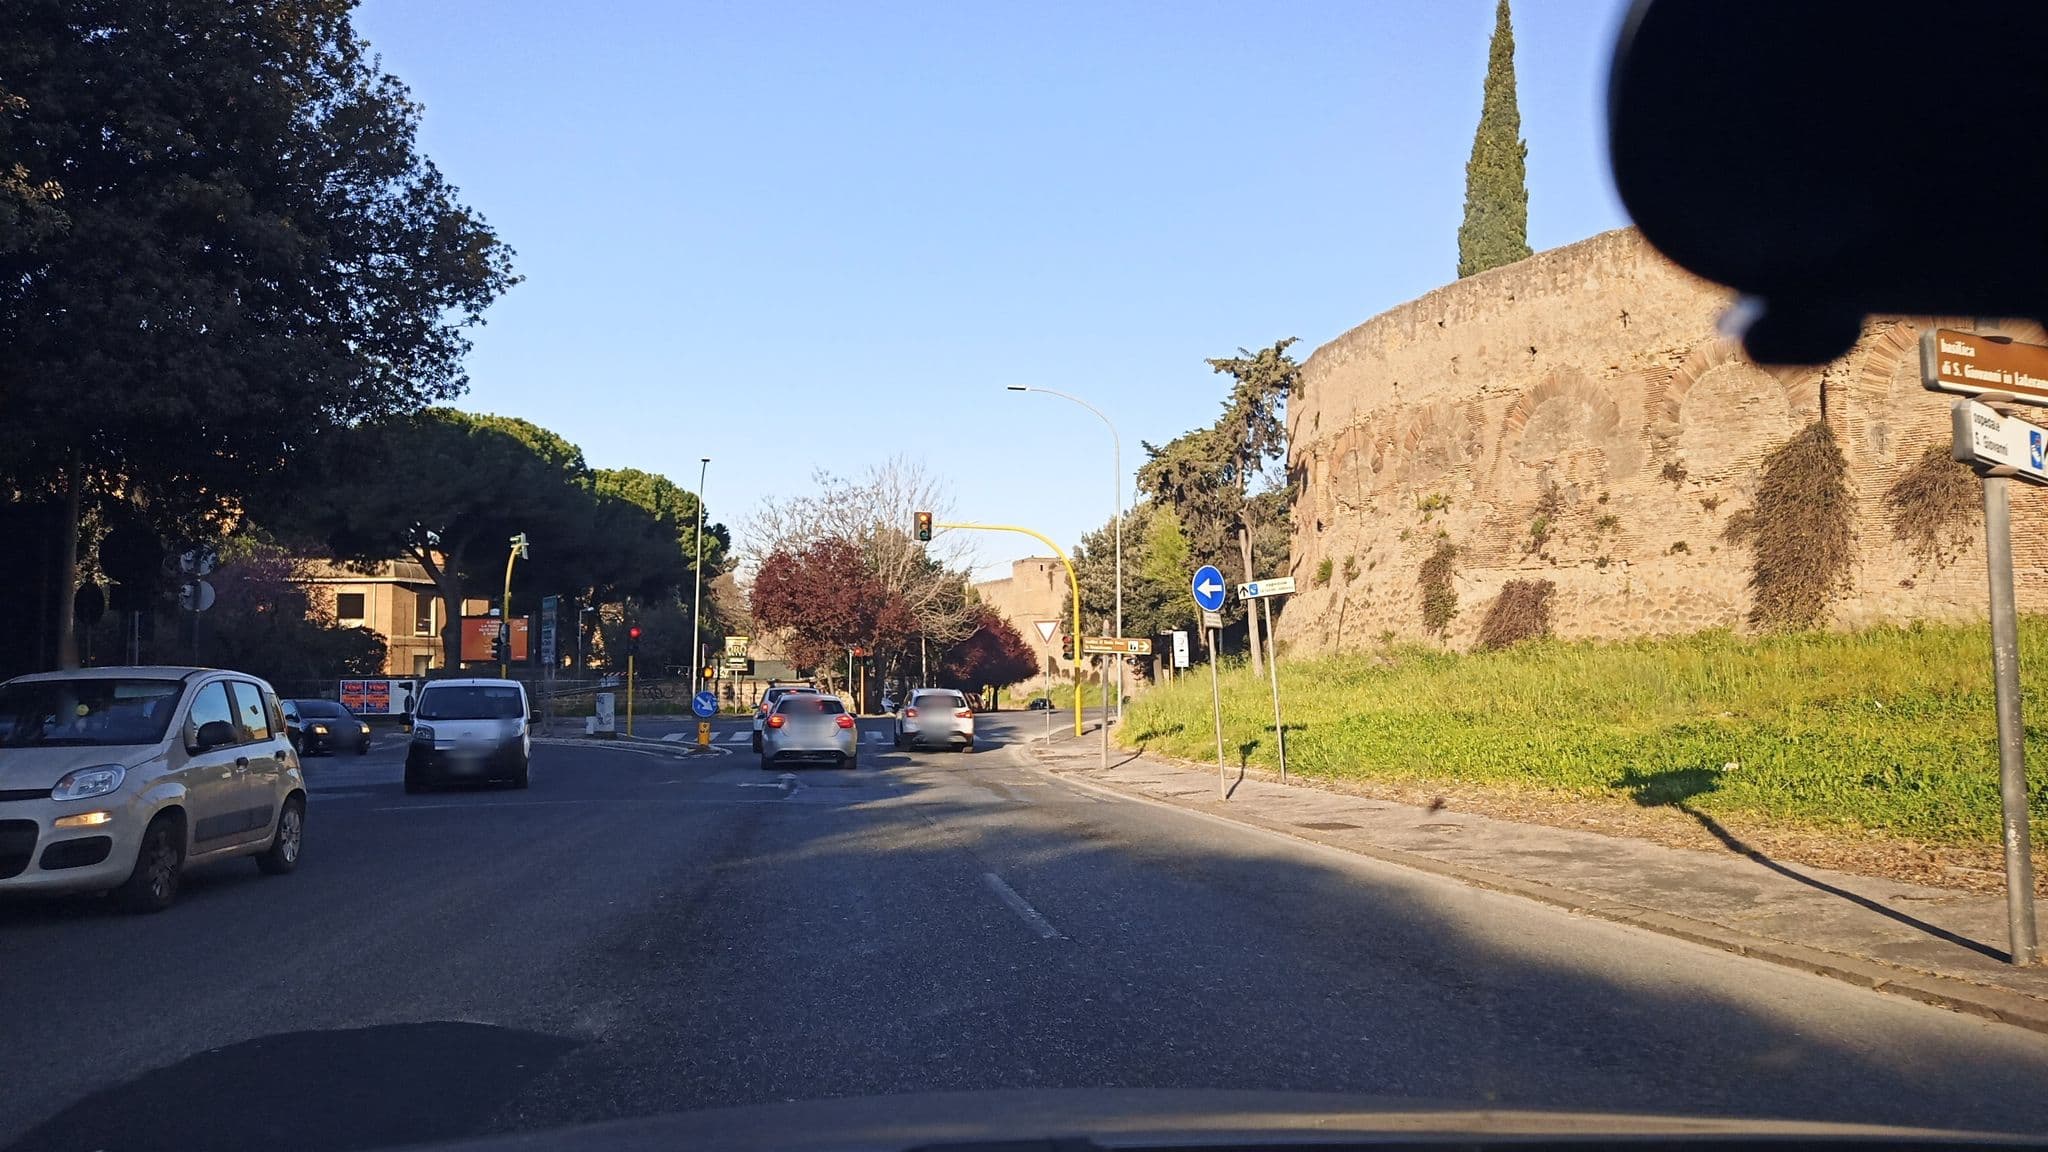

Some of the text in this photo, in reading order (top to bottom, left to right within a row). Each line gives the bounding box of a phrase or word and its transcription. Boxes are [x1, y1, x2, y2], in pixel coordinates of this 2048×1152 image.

[1940, 339, 1976, 357] basilica
[1942, 361, 1951, 375] di
[1952, 362, 1963, 377] S.
[1964, 364, 2002, 382] Giovanni
[2014, 372, 2048, 390] Lateran
